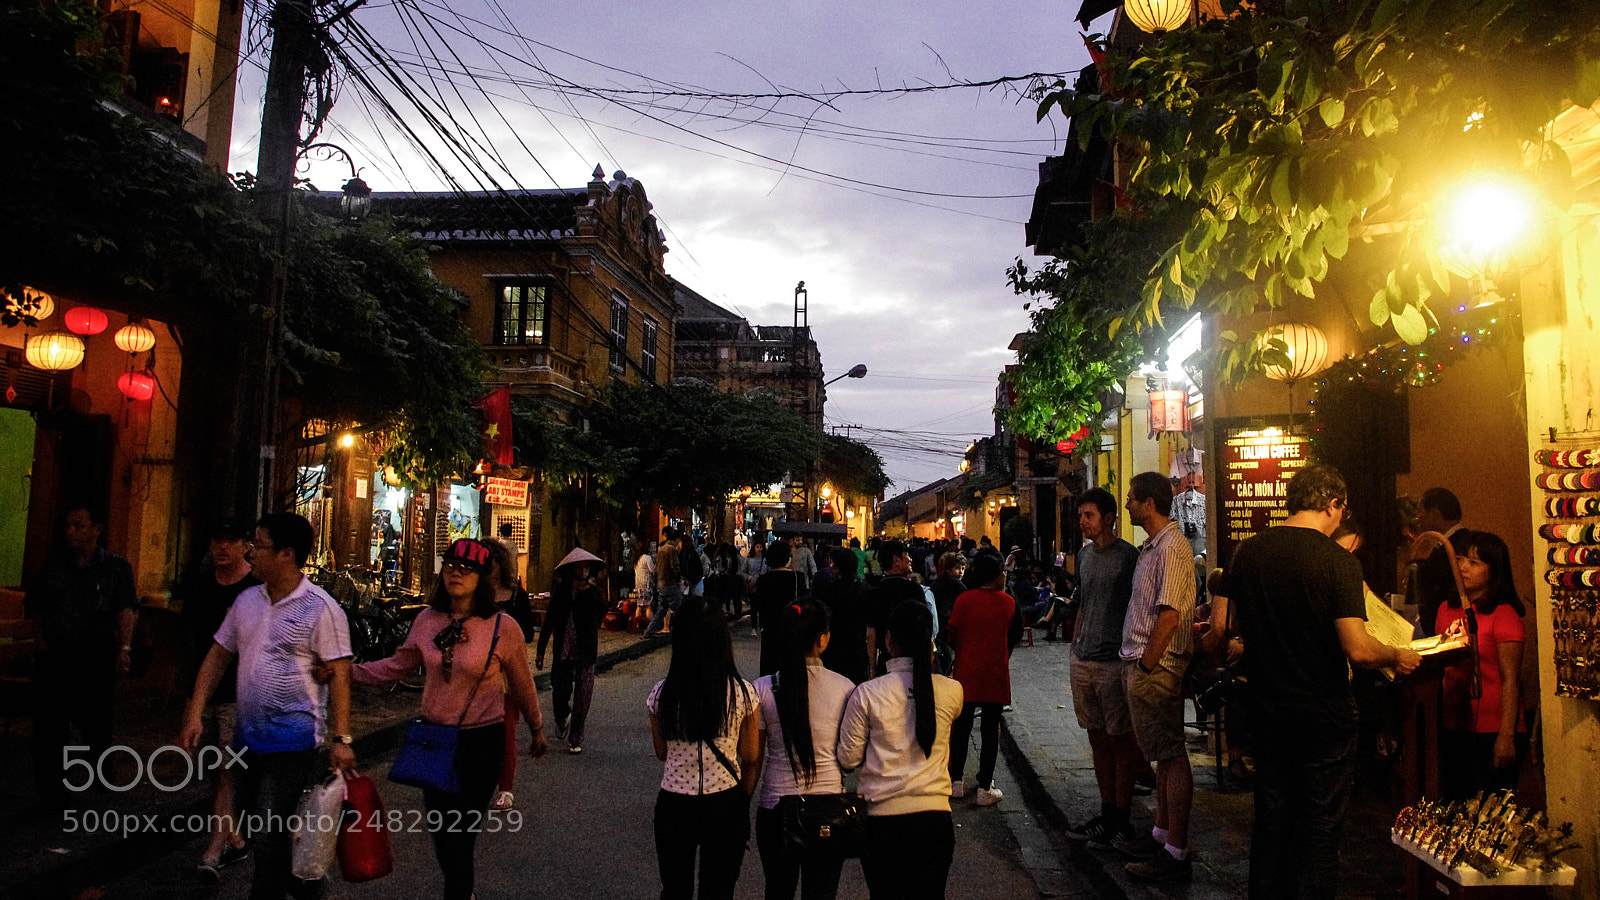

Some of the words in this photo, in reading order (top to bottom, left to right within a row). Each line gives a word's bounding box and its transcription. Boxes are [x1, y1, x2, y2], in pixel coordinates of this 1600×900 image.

[1240, 446, 1270, 460] ITALIAN
[1270, 444, 1300, 459] COFFEE
[1229, 461, 1259, 470] CAPPUCCINO
[488, 486, 500, 496] ART
[500, 488, 525, 499] STAMPS
[1237, 480, 1253, 497] CÁC
[1254, 479, 1274, 497] MÓN
[1275, 479, 1287, 497] ĂN
[1244, 500, 1278, 508] TRADITIONAL
